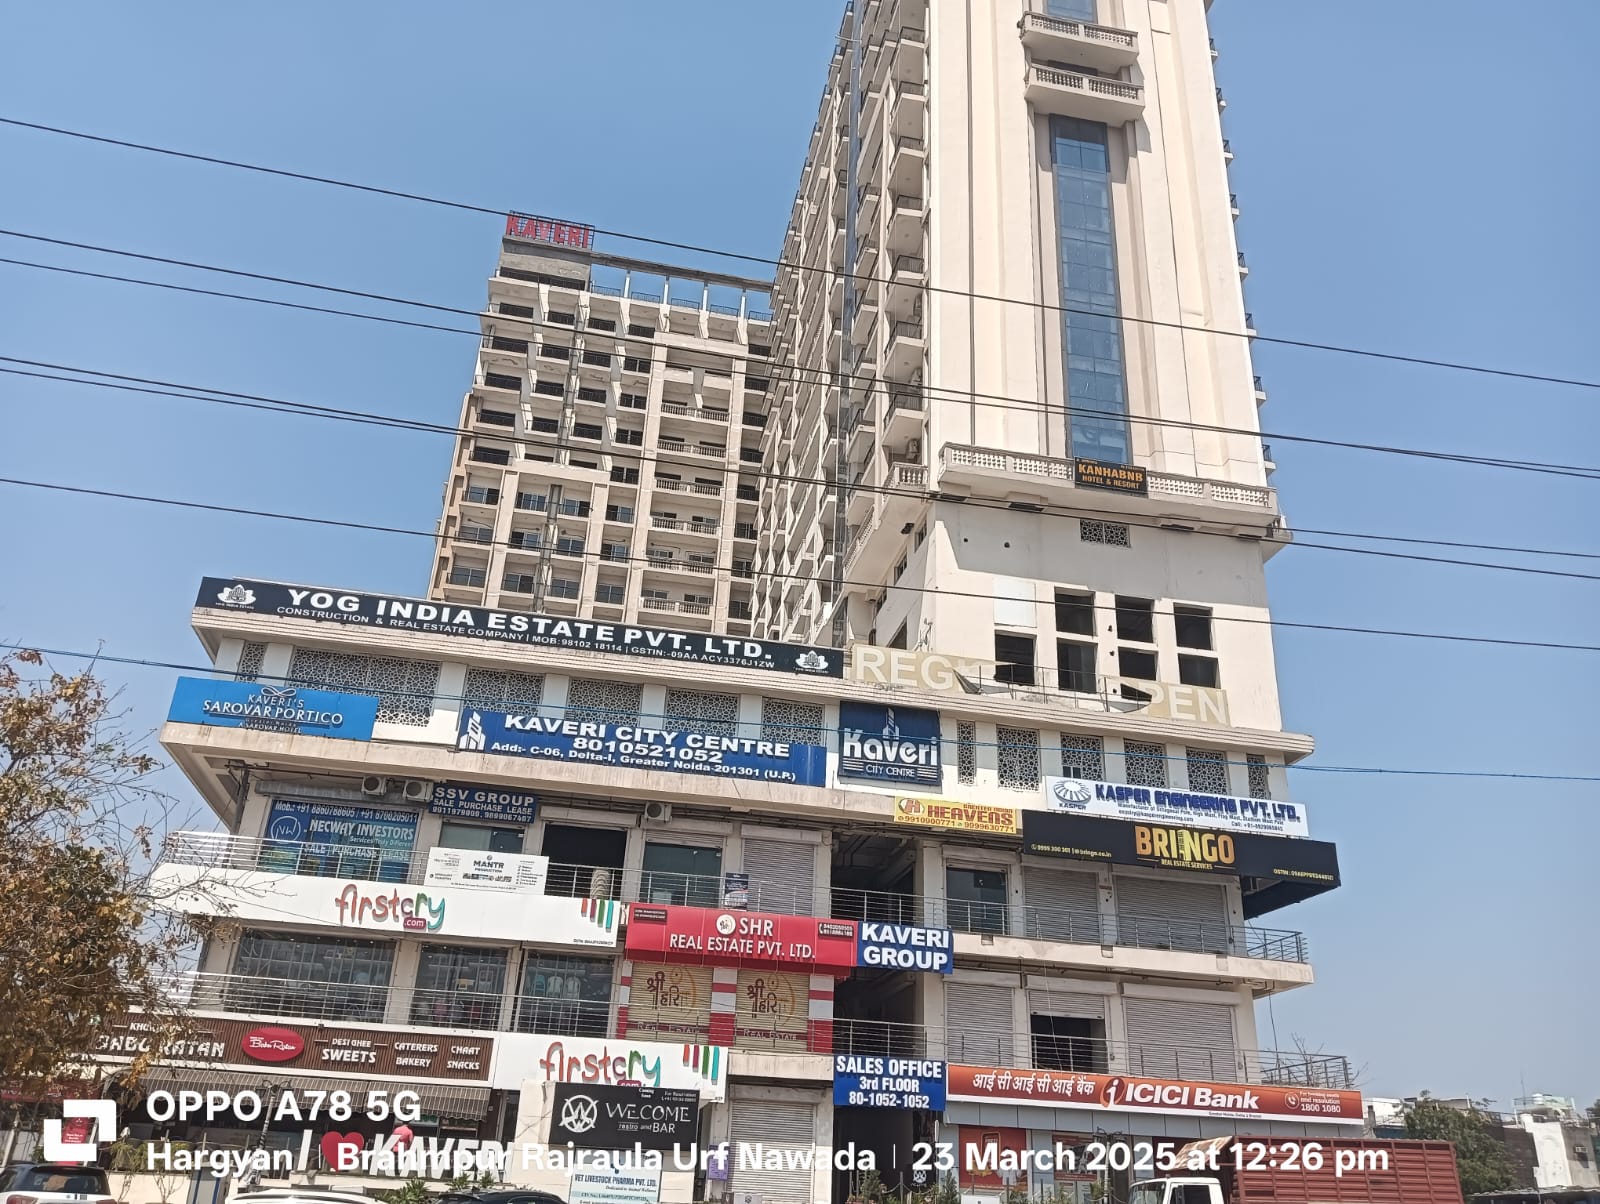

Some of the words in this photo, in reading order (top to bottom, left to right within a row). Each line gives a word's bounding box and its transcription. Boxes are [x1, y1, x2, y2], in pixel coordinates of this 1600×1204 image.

[505, 214, 590, 249] KAVERI
[1078, 463, 1143, 482] KANHABNB
[1082, 475, 1104, 484] HOTEL
[1114, 480, 1140, 489] RESORT
[276, 606, 369, 623] CONSTRUCTION
[375, 617, 383, 625] &
[389, 619, 421, 629] REAL
[423, 623, 465, 634] ESTATE
[467, 628, 524, 640] COMPANY
[288, 589, 360, 612] YOG
[376, 600, 475, 626] INDIA
[487, 613, 614, 641] ESTATE
[624, 628, 692, 651] PVT.
[705, 637, 772, 660] LTD.
[247, 694, 305, 709] KAVERI'S
[202, 699, 272, 717] SAROVAR
[274, 708, 344, 725] PORTICO
[505, 714, 607, 738] KAVERI
[615, 726, 678, 745] CITY
[686, 734, 790, 757] CENTRE
[572, 737, 723, 764] 8010521052
[491, 742, 526, 753] Add:-
[530, 746, 564, 758] C-06,
[620, 755, 670, 768] Greater
[673, 759, 760, 777] Noida-201301
[764, 769, 796, 782] (U.P.)
[865, 764, 884, 774] CITY
[885, 764, 916, 777] CENTRE
[433, 798, 455, 807] SALE
[458, 801, 503, 812] PURCHASE
[507, 806, 533, 815] LEASE
[434, 787, 470, 800] SSV
[474, 792, 534, 807] GROUP
[1059, 802, 1087, 810] KASPER
[1095, 784, 1152, 806] KASPER
[1240, 800, 1271, 817] PVT.
[1272, 803, 1301, 823] LTD.
[297, 804, 310, 813] +91
[361, 809, 373, 820] +91
[927, 805, 1013, 825] HEAVENS
[309, 818, 356, 836] NECWAY
[357, 822, 414, 840] INVESTORS
[1135, 825, 1235, 864] BRINGO
[1161, 858, 1173, 866] REAL
[1174, 859, 1191, 868] ESTATE
[404, 919, 425, 927] .com
[739, 917, 773, 936] SHR
[862, 923, 949, 948] KAVERI
[670, 933, 703, 949] REAL
[707, 937, 753, 954] ESTATE
[757, 940, 785, 956] PVT.
[789, 943, 815, 958] LTD.
[863, 946, 948, 970] GROUP
[332, 1038, 350, 1046] DESI
[351, 1040, 372, 1048] GHEE
[394, 1042, 439, 1053] CATERERS
[451, 1045, 480, 1055] CHAAT
[322, 1049, 376, 1063] SWEETS
[396, 1057, 431, 1068] BAKERY
[446, 1061, 480, 1070] SNACKS
[836, 1055, 884, 1075] SALES
[888, 1059, 942, 1078] OFFICE
[860, 1076, 879, 1090] 3rd
[882, 1077, 919, 1093] FLOOR
[973, 1070, 996, 1092] आई
[997, 1071, 1012, 1090] सी
[1012, 1073, 1035, 1094] आई
[1037, 1073, 1051, 1092] सी
[1052, 1075, 1076, 1096] आई
[1076, 1075, 1096, 1095] बैंक
[849, 1091, 930, 1108] 80-1052-1052
[1125, 1083, 1191, 1105] ICICI
[1194, 1088, 1260, 1110] Bank
[1301, 1104, 1320, 1112] 1800
[1322, 1105, 1341, 1113] 1080
[652, 1122, 675, 1133] BAR
[585, 1175, 611, 1184] LIVESTOCK
[612, 1177, 635, 1185] PHARMA
